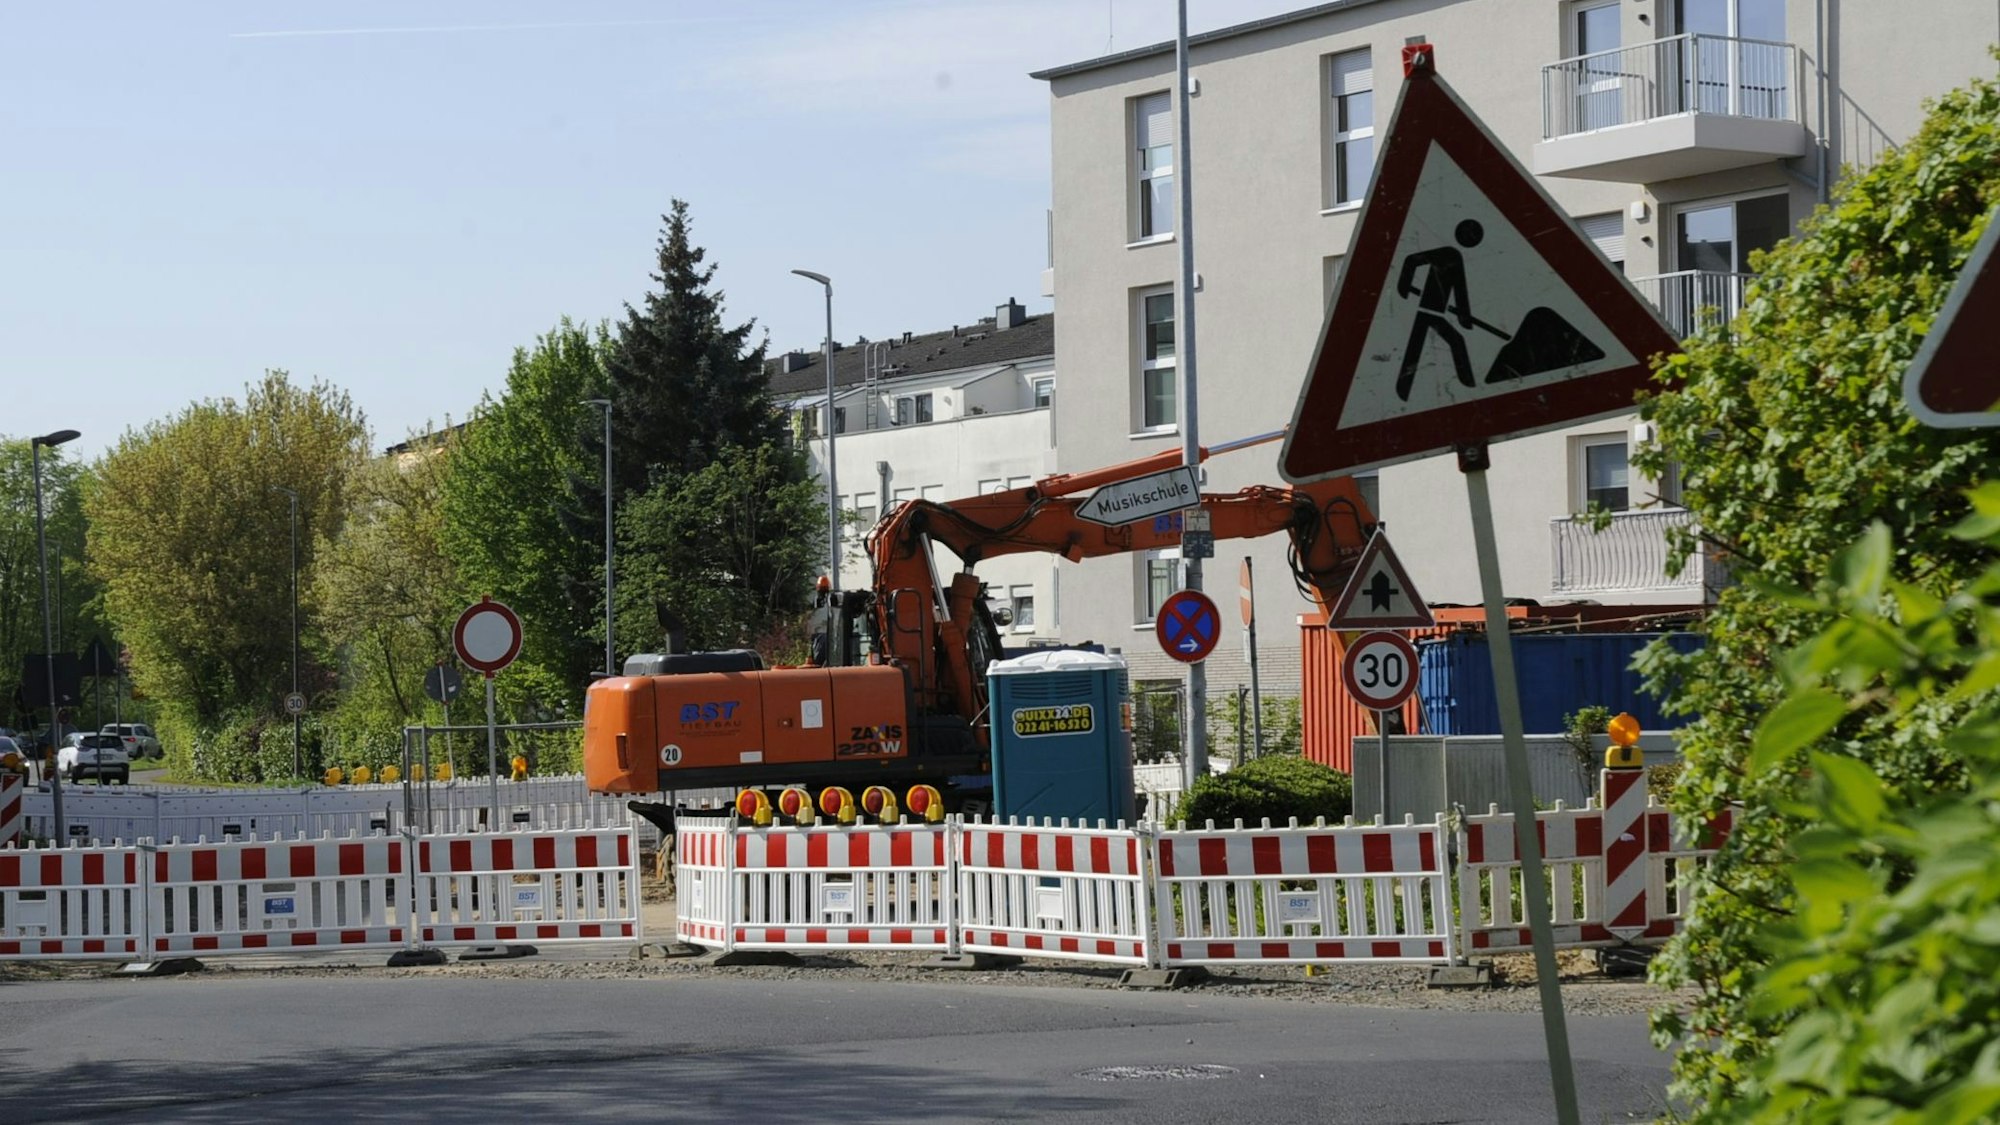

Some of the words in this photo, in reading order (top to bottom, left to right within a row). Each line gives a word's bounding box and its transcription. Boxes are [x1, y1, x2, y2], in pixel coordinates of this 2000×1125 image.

[1097, 482, 1189, 515] Musikschule
[1360, 653, 1402, 687] 30
[289, 699, 302, 708] 30
[680, 701, 740, 722] BST
[851, 724, 902, 740] ZAXIS
[665, 748, 678, 761] 20
[838, 741, 901, 755] 220W
[518, 892, 535, 900] BST
[1290, 899, 1309, 907] BST
